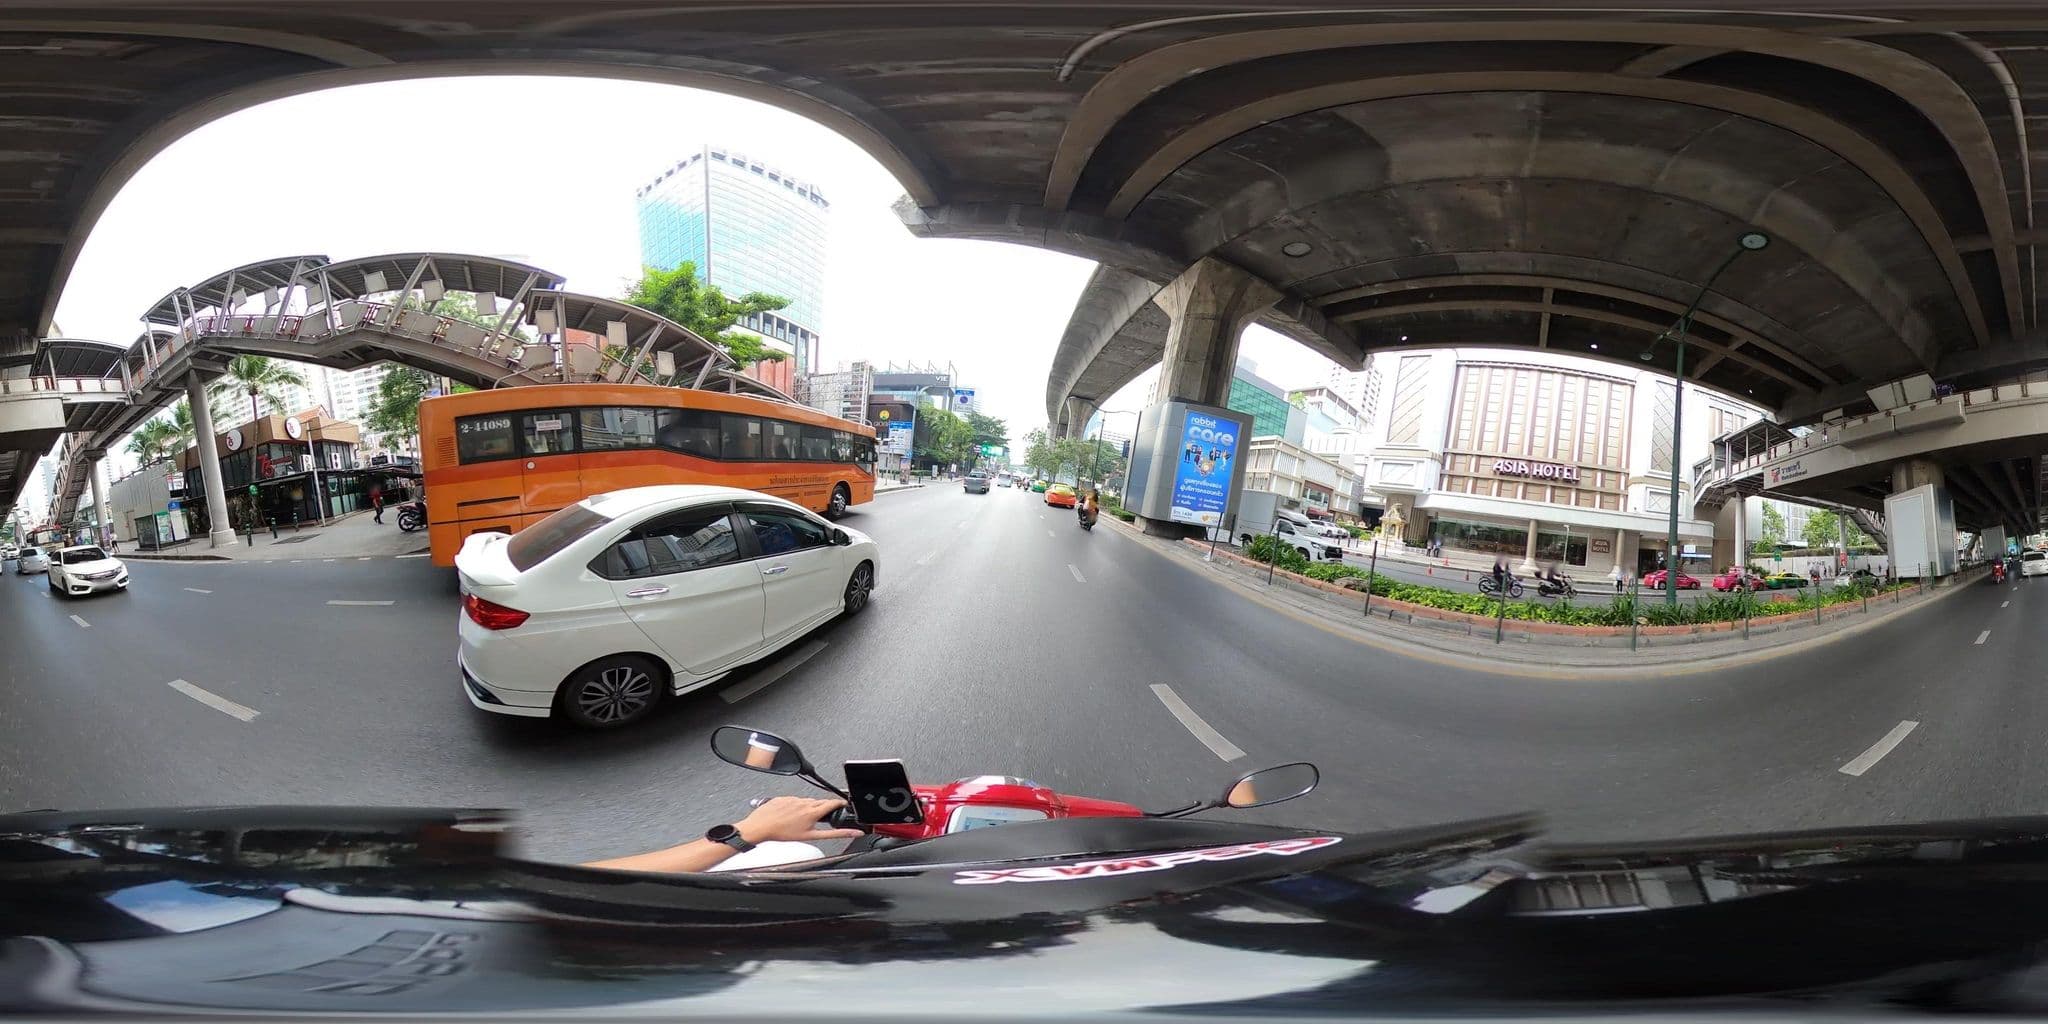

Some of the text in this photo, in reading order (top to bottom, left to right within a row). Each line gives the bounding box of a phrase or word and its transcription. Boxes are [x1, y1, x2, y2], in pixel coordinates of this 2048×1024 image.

[1191, 416, 1217, 429] rabbit
[1188, 426, 1234, 447] care
[1492, 459, 1581, 481] ASIA HOTEL
